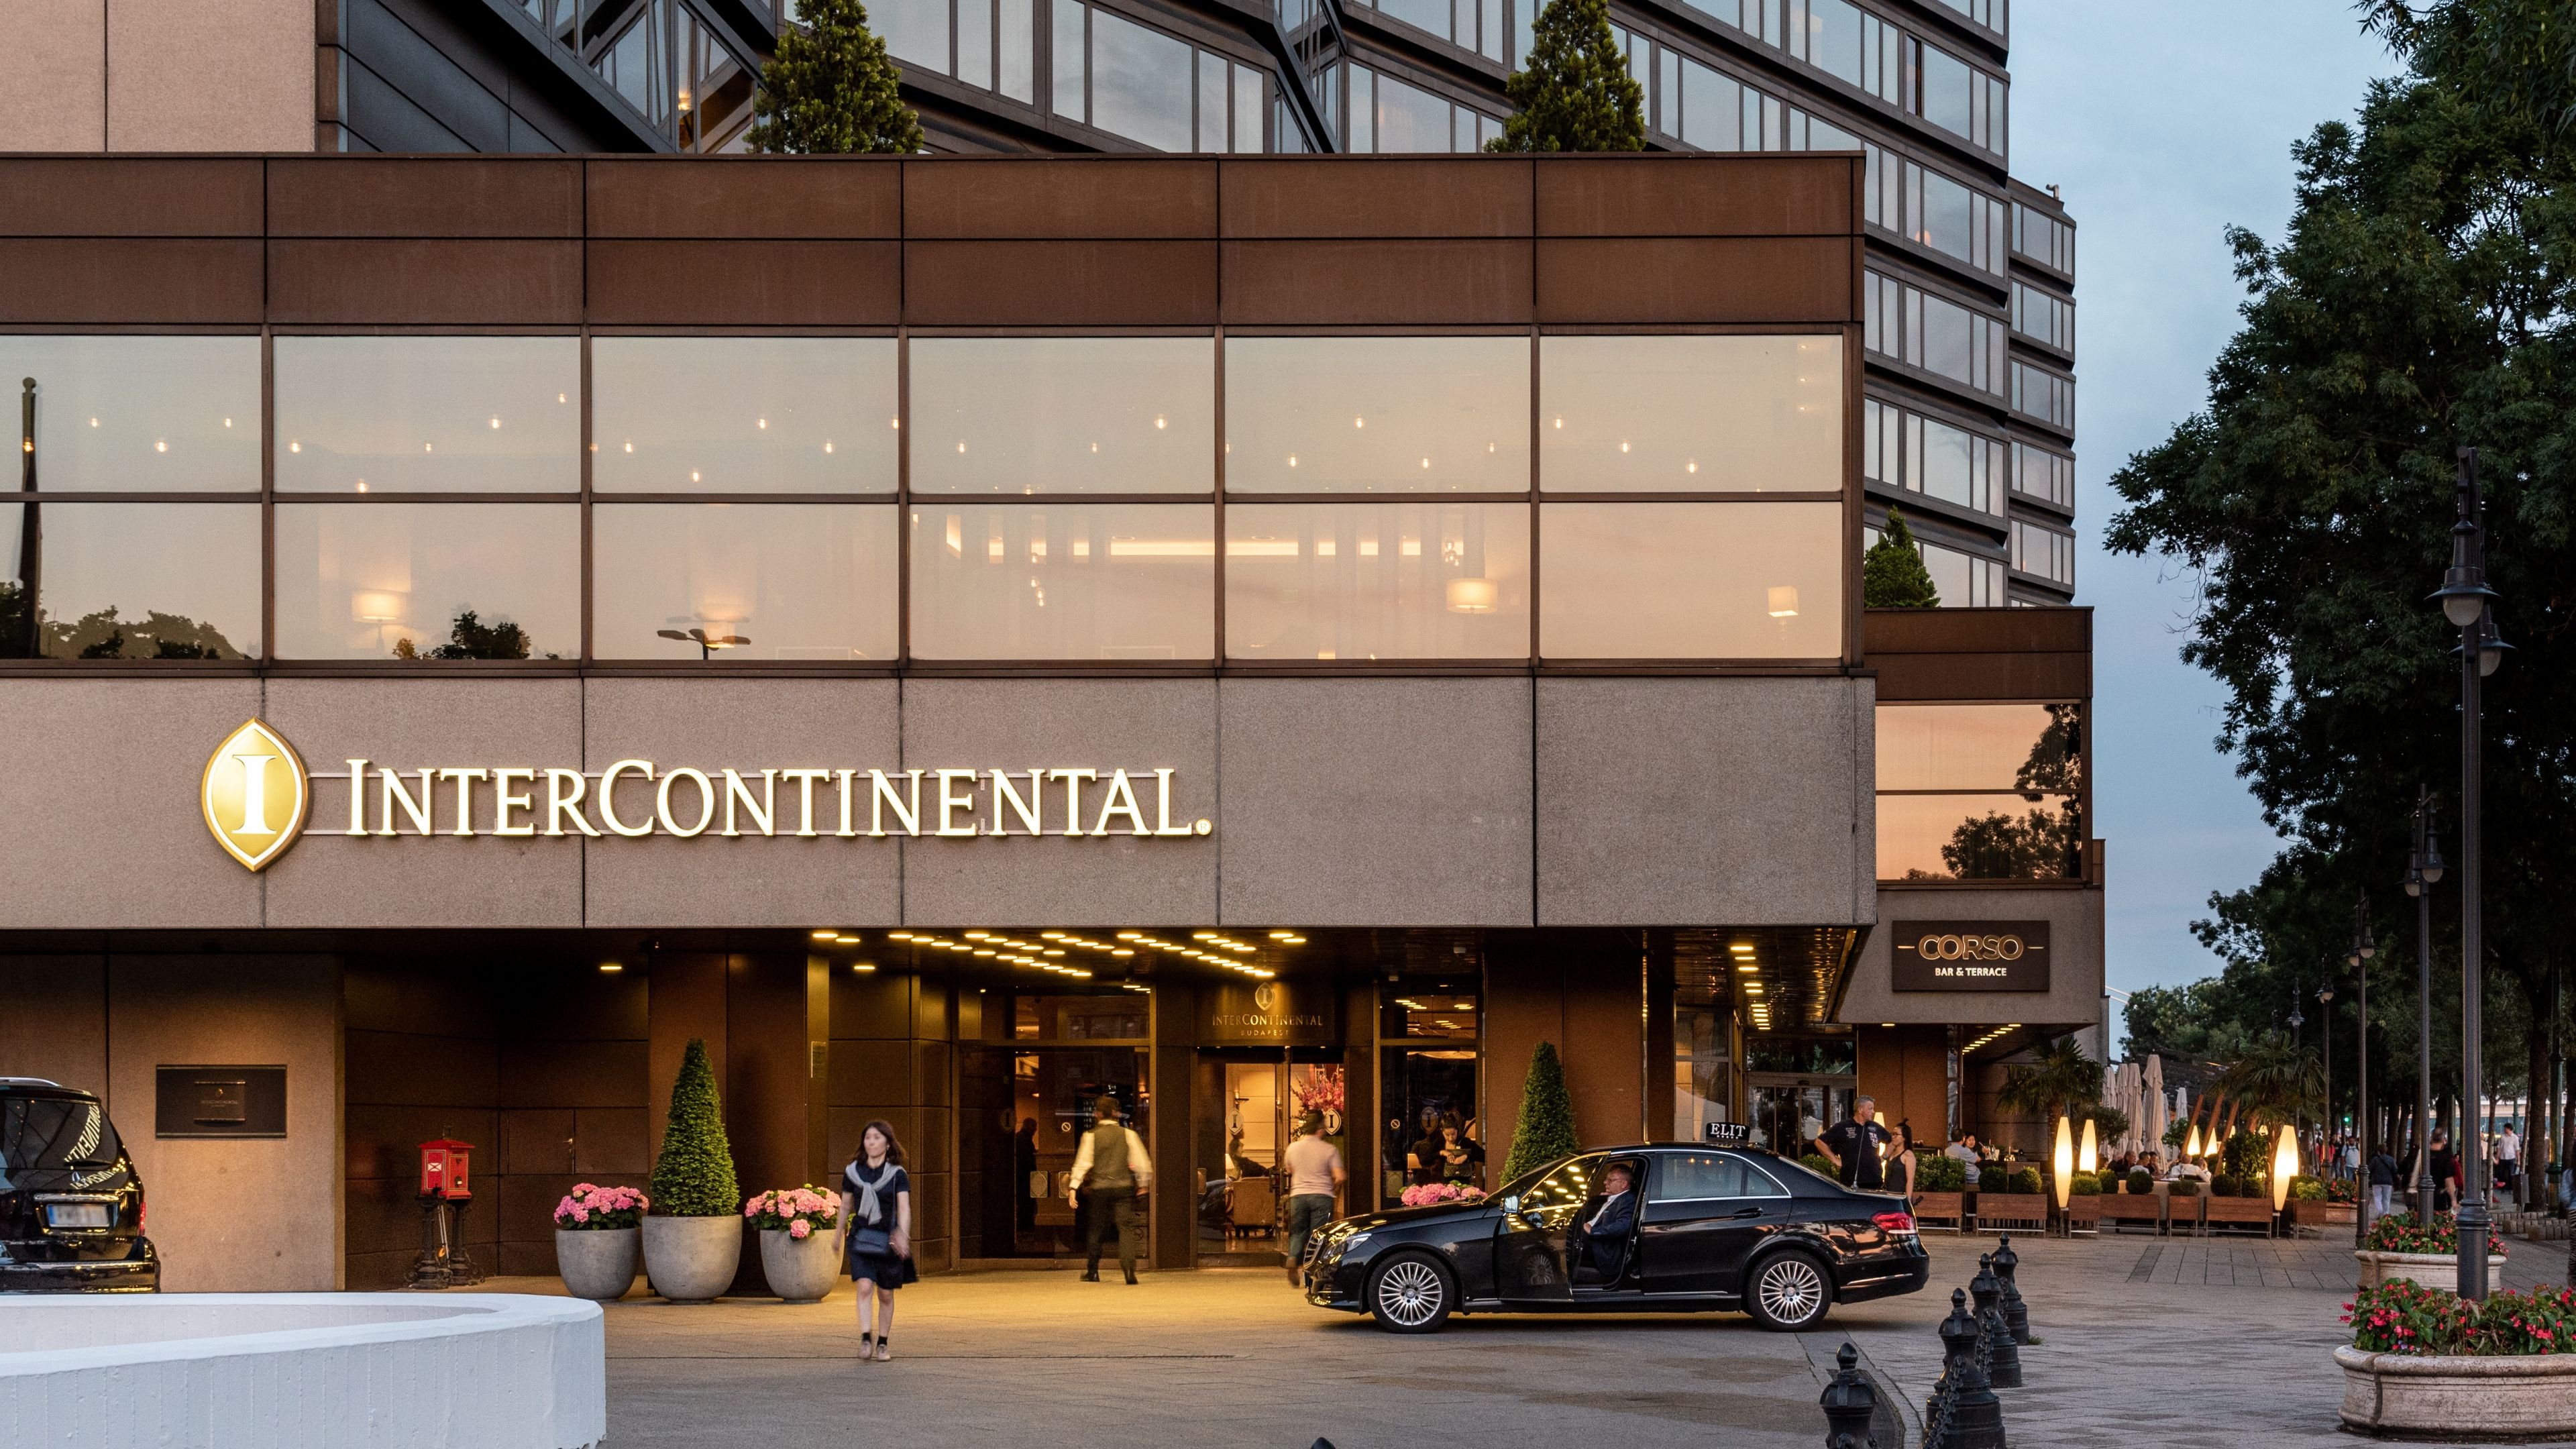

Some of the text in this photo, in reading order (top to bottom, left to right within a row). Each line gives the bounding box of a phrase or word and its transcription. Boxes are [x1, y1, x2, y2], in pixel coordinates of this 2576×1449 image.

[231, 754, 277, 835] I
[1918, 934, 2024, 961] CORSO
[1935, 967, 2007, 977] BAR & TERRACE
[1212, 1014, 1323, 1026] INTERCONTINENTAL
[1711, 1123, 1746, 1137] ELIT
